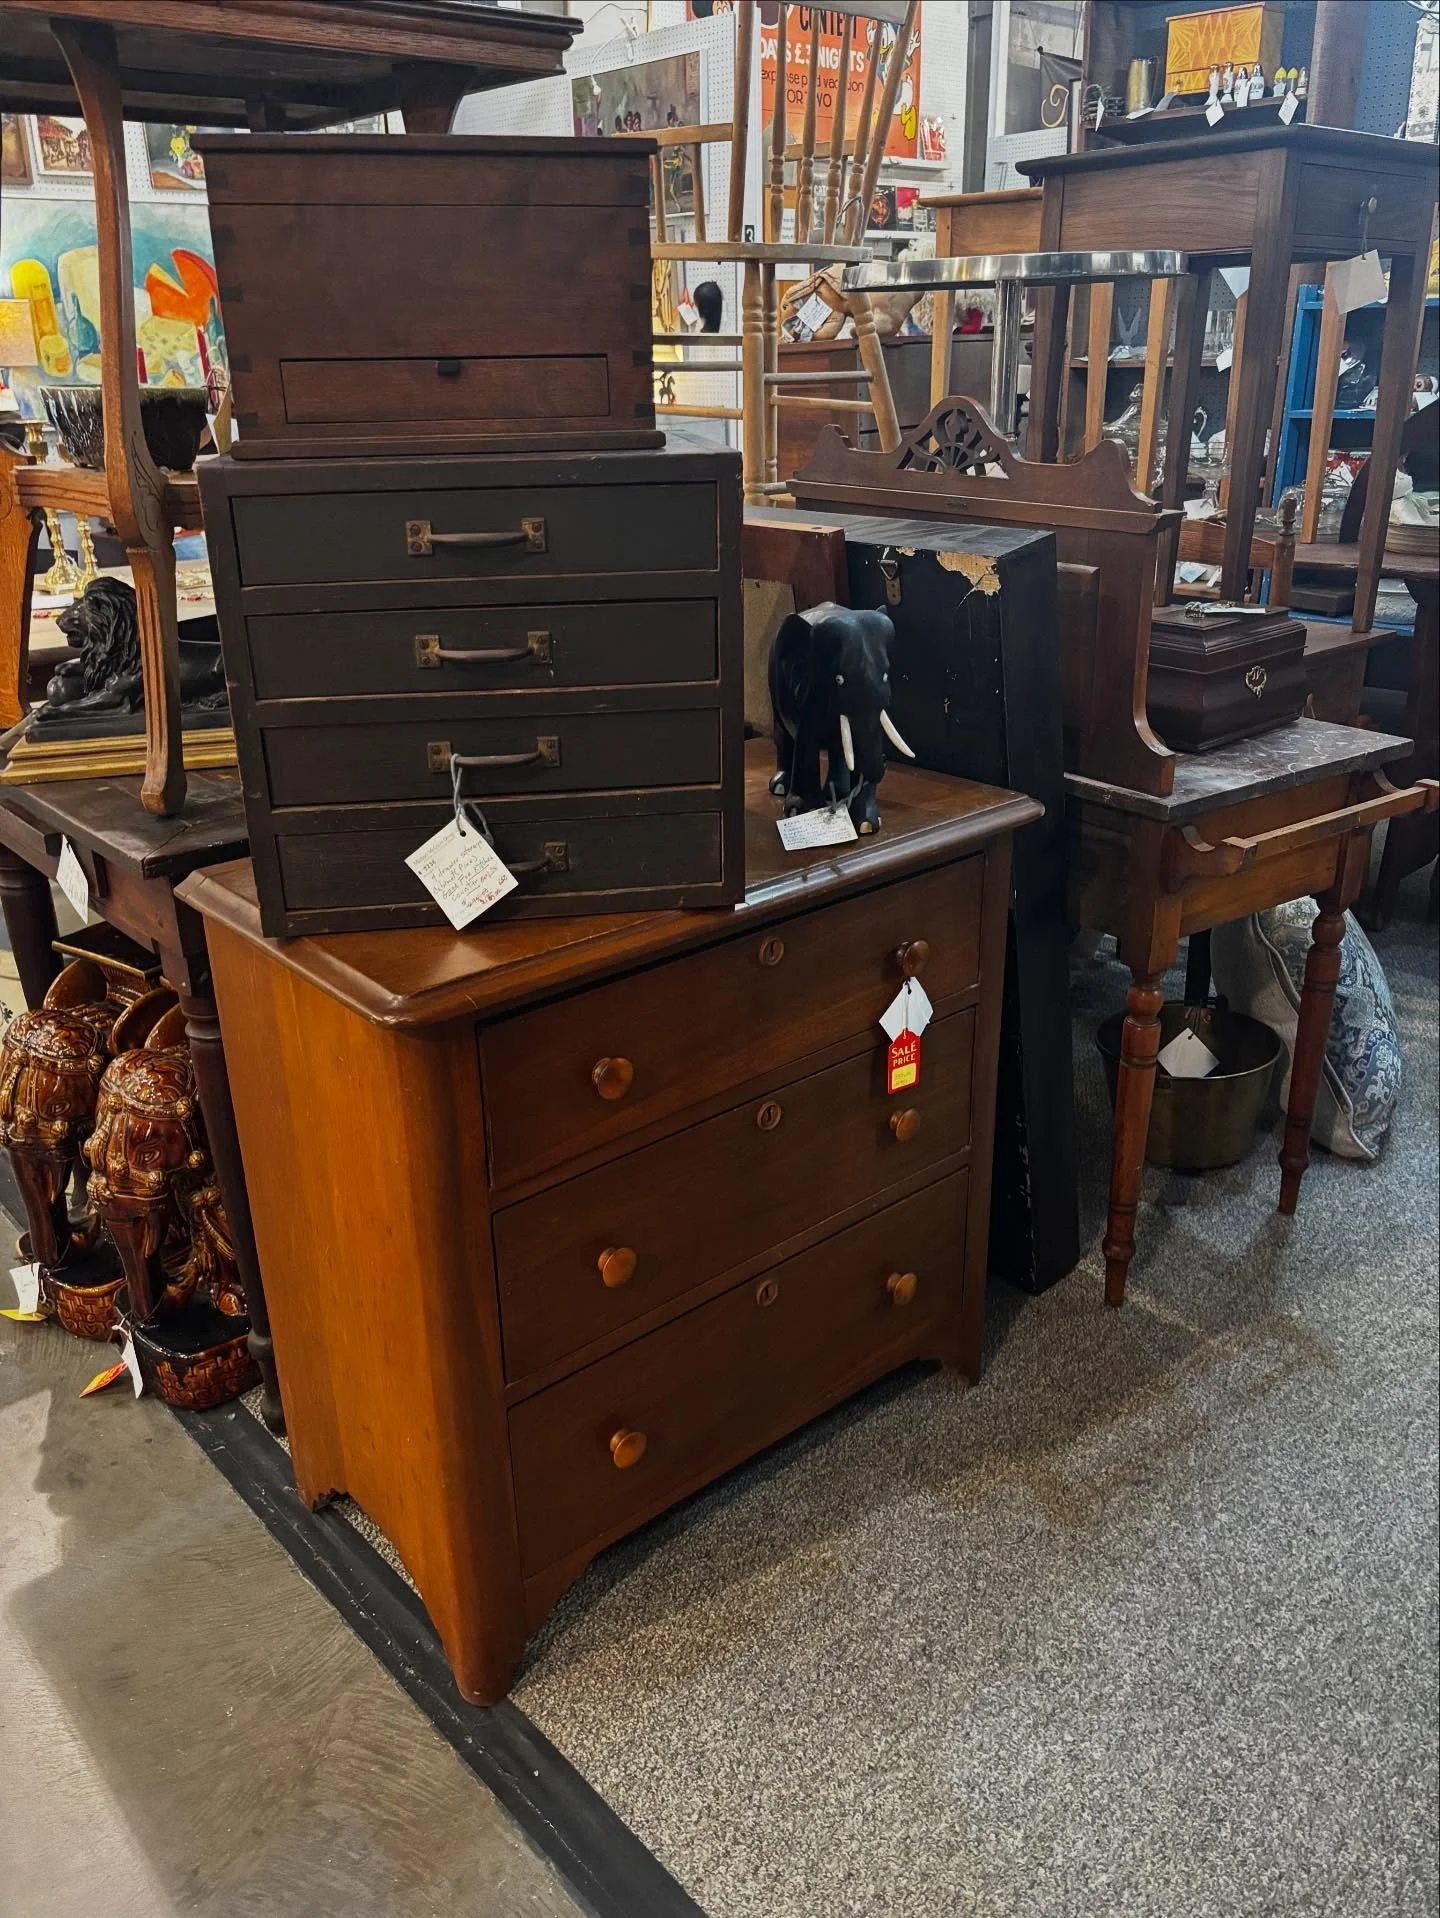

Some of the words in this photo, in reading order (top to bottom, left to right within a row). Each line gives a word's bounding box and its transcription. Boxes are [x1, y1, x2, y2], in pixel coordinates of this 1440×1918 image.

[817, 46, 865, 73] NIGTS
[892, 1041, 917, 1059] SALE
[893, 1053, 916, 1067] PRICE
